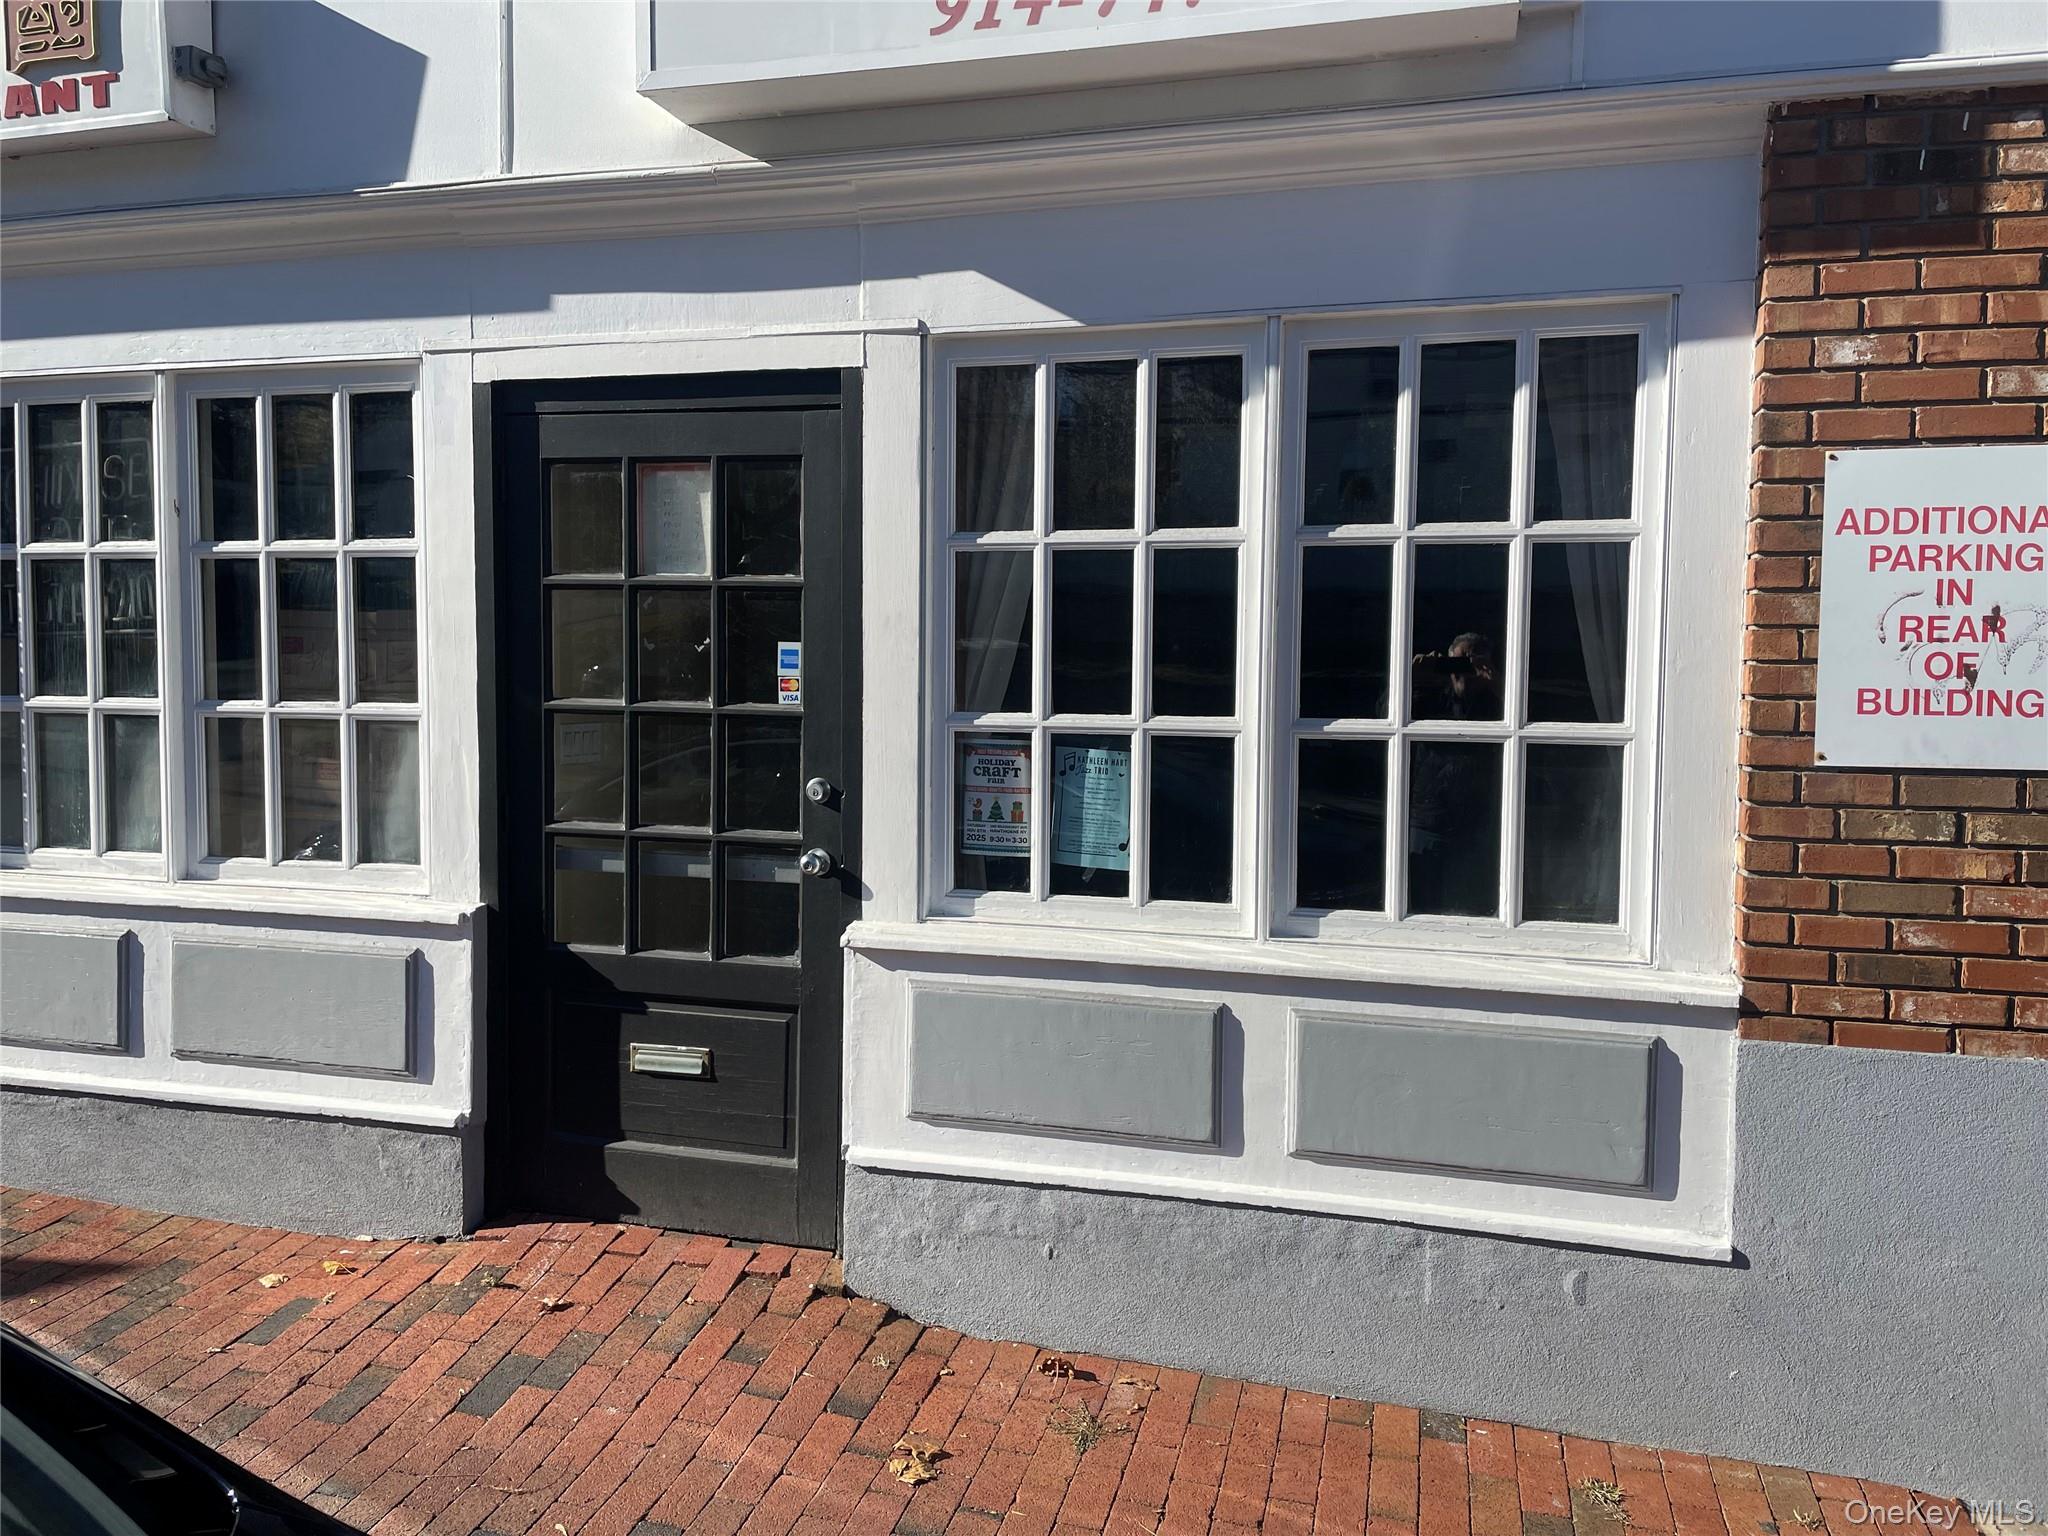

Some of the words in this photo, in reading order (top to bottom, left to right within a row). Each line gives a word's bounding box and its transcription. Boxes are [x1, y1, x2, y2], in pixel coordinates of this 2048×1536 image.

[0, 72, 118, 119] ANT
[1835, 505, 2048, 536] ADDITIONA
[1869, 542, 2044, 572] PARKING
[1936, 578, 1973, 606] IN
[1899, 615, 2007, 643] REAR
[1924, 651, 1980, 680] OF
[782, 694, 799, 702] VISA
[1856, 687, 2044, 718] BUILDING
[1094, 767, 1109, 775] TRIO
[966, 833, 986, 842] 2025
